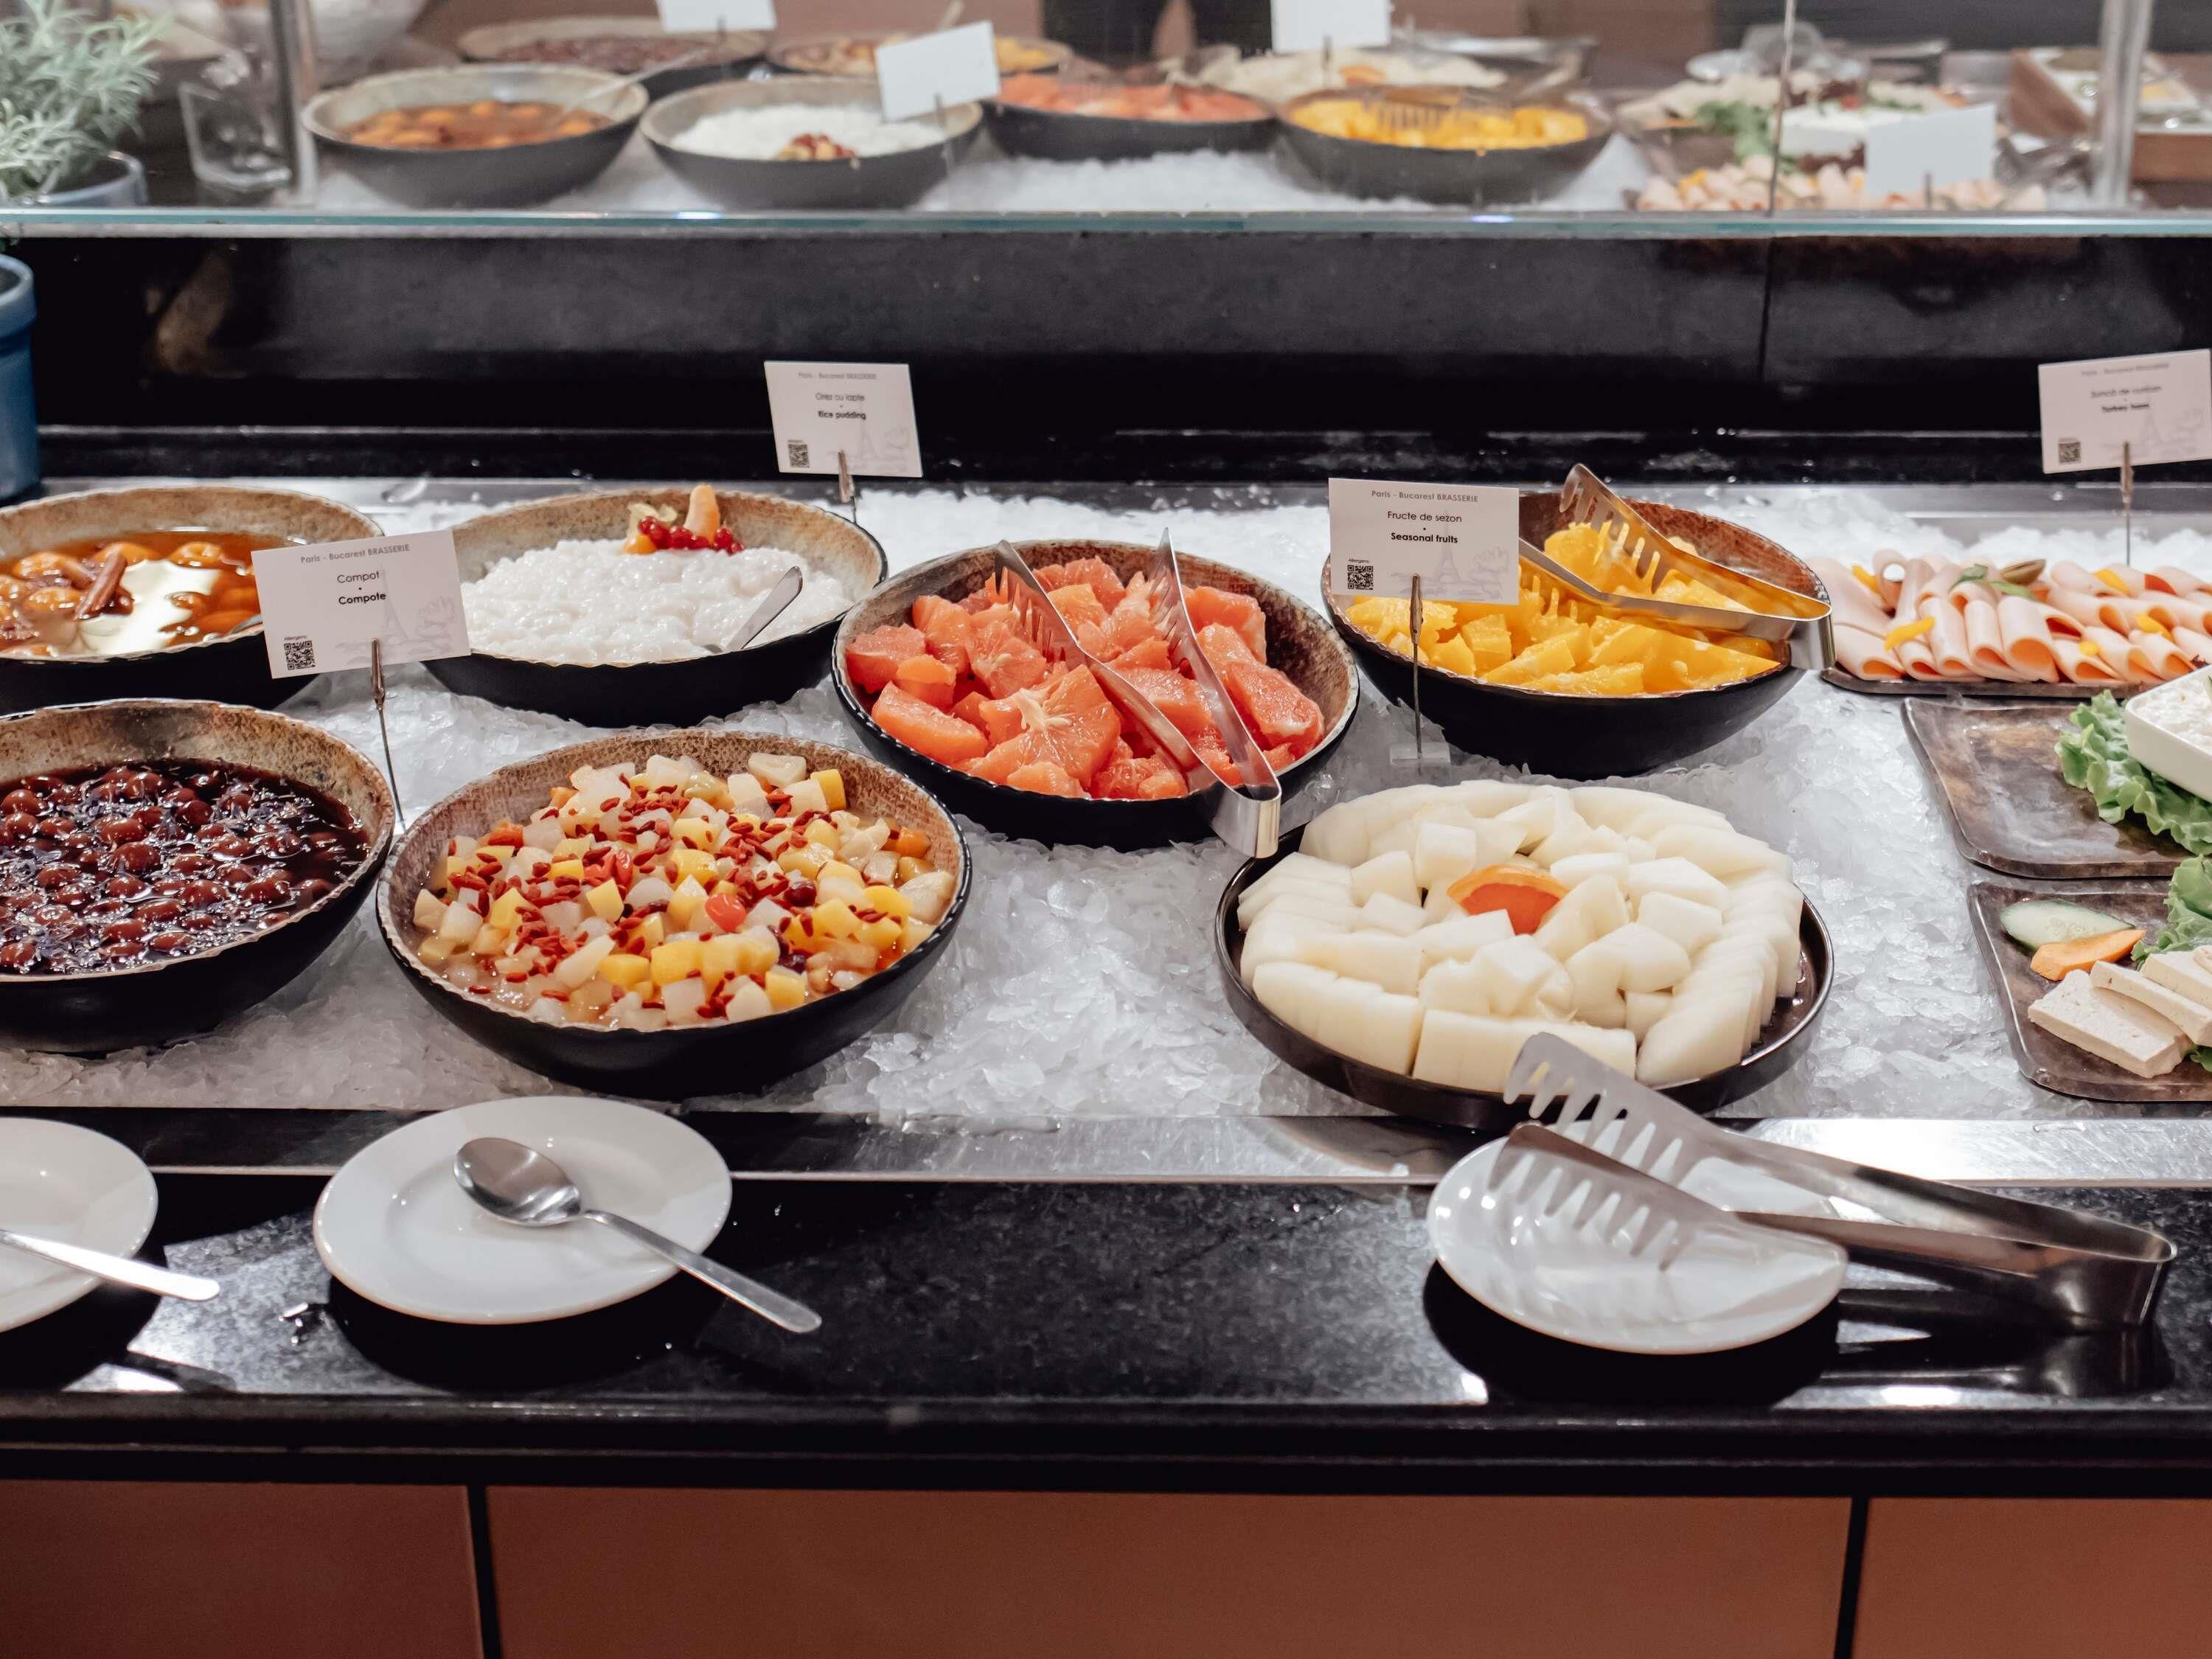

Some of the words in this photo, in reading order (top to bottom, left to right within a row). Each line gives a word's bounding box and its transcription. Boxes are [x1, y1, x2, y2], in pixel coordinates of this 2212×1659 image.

[845, 394, 866, 403] lapte
[818, 410, 833, 418] Rice
[835, 411, 866, 420] pudding
[1399, 492, 1435, 500] Bucarest
[1436, 494, 1478, 503] BRASSERIE
[1387, 511, 1417, 521] Fructe
[1419, 513, 1433, 521] de
[1435, 515, 1462, 523] sezon
[1391, 532, 1433, 543] Seasonal
[1436, 535, 1458, 543] fruits
[300, 555, 321, 563] Paris
[329, 549, 366, 560] Bucarest
[367, 543, 411, 555] BRASSERIE
[336, 571, 380, 584] Compot
[338, 592, 387, 605] Compote
